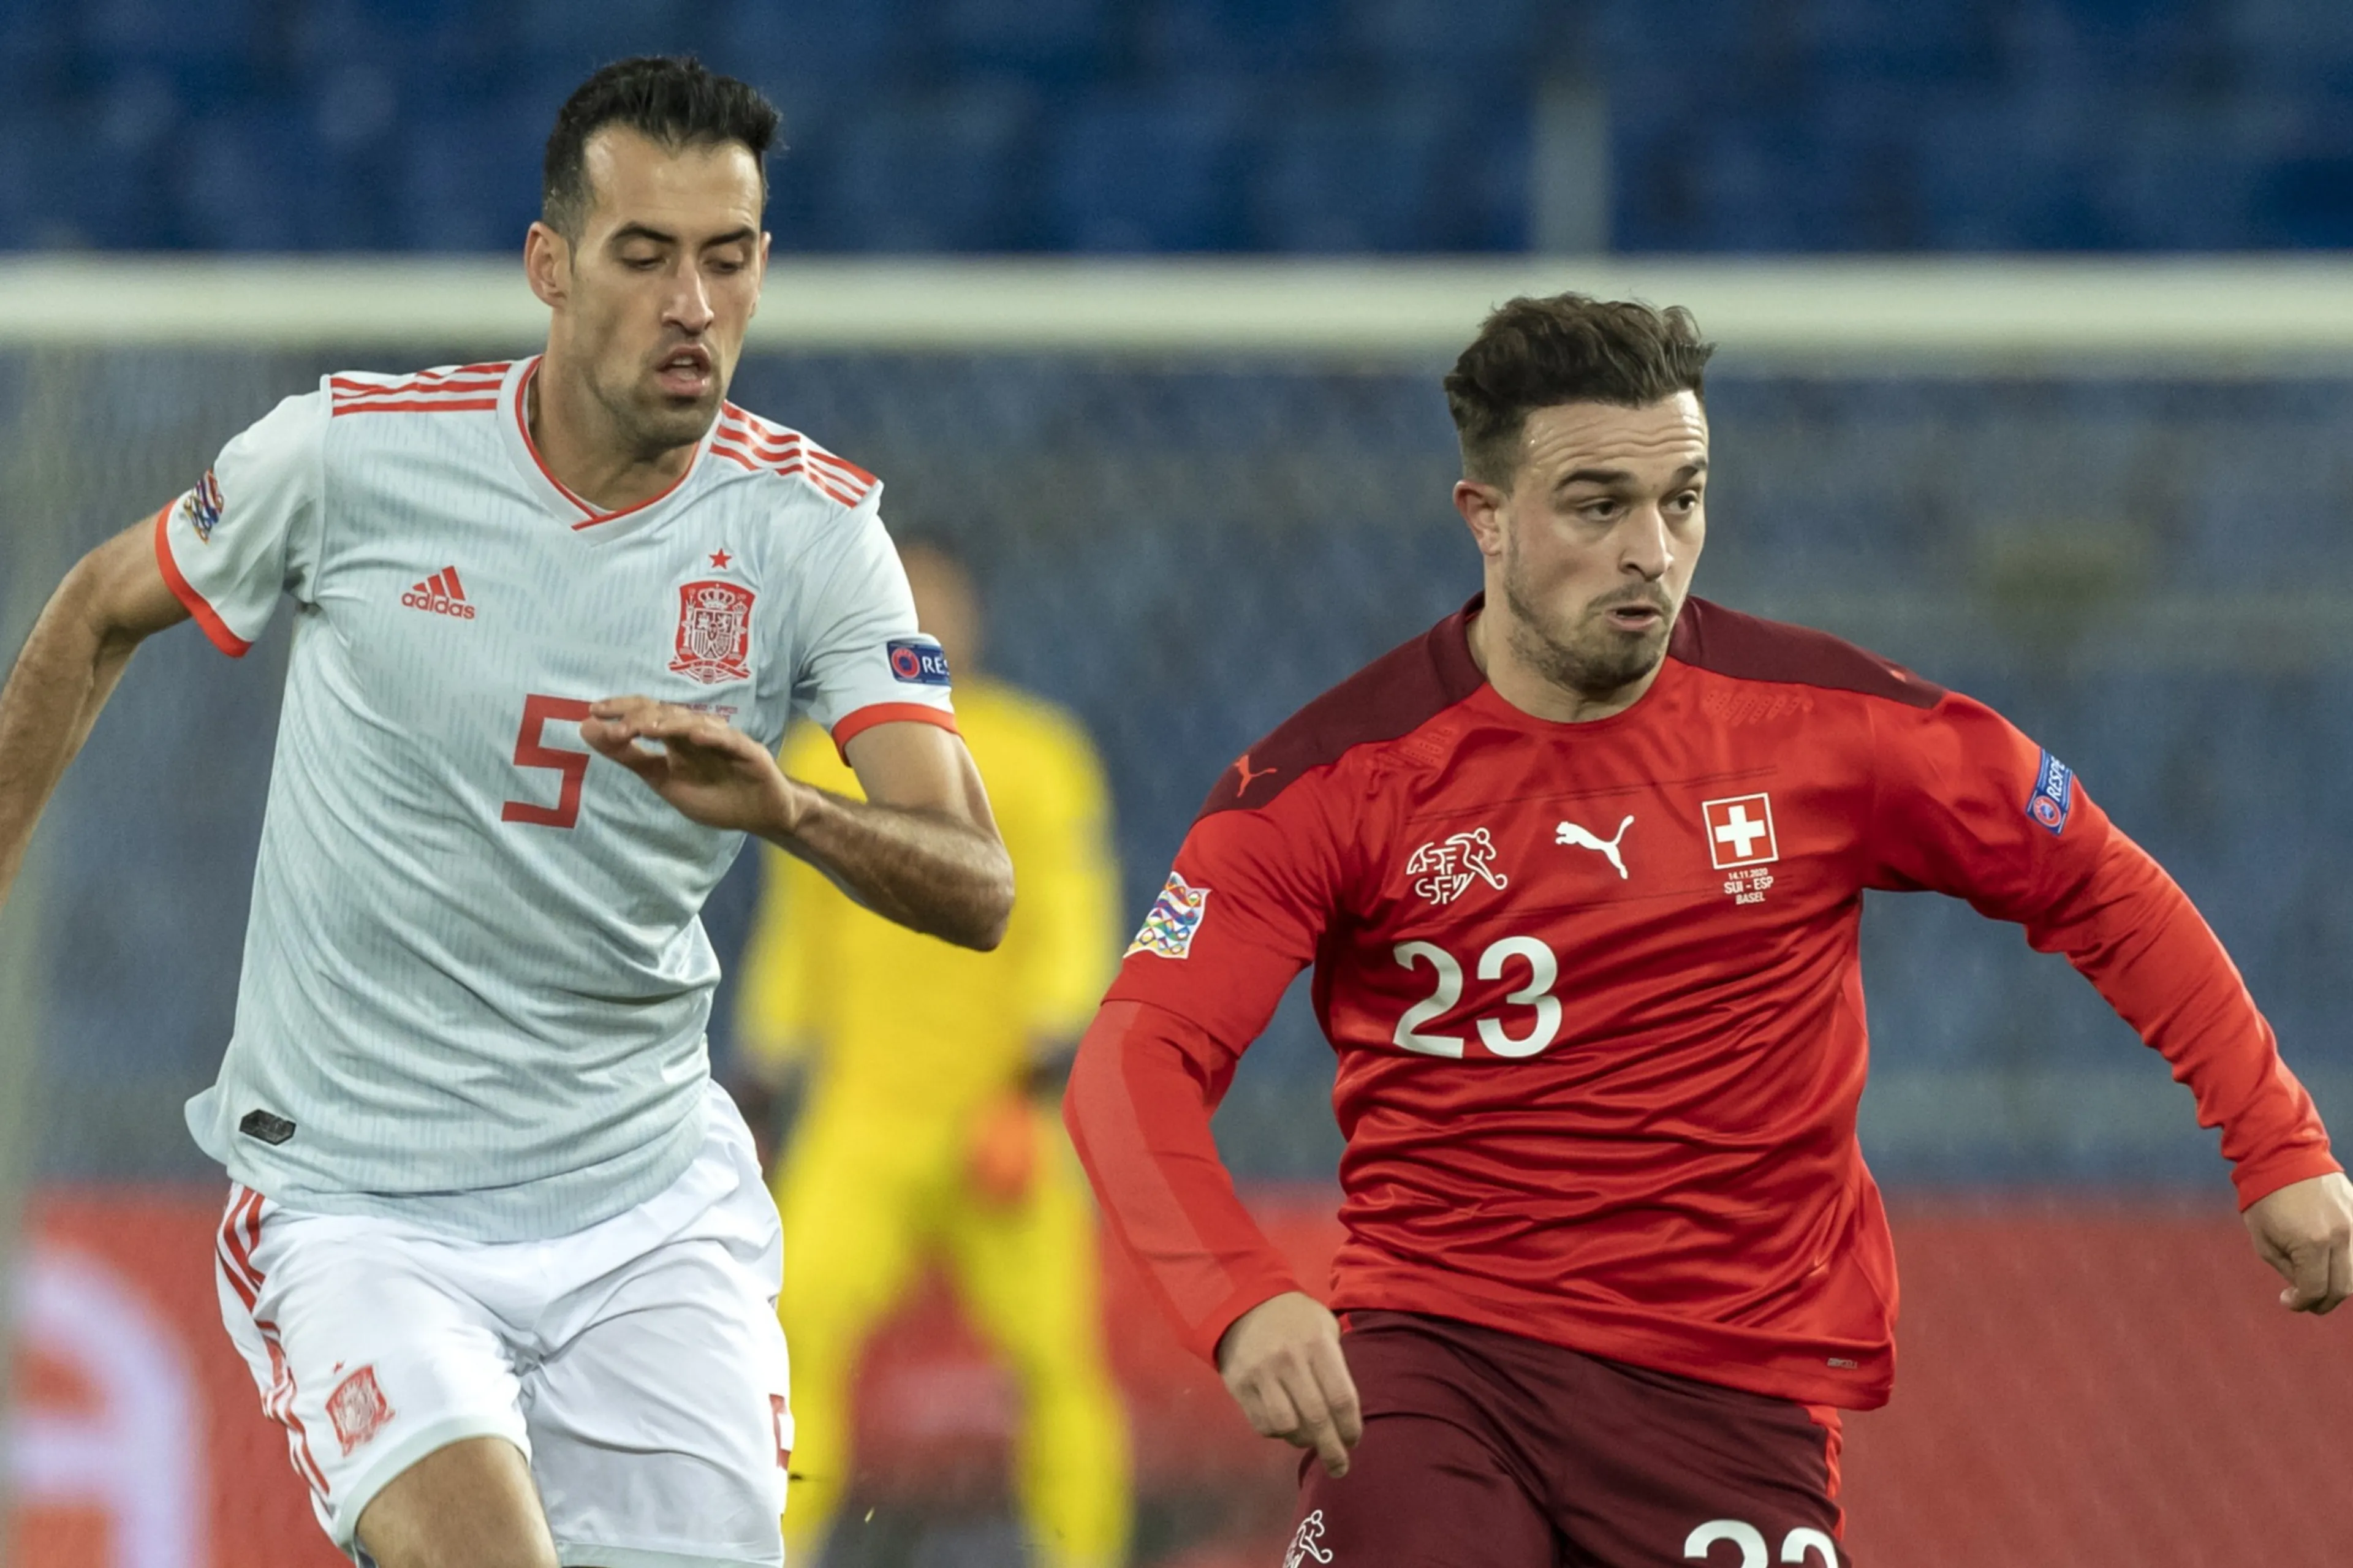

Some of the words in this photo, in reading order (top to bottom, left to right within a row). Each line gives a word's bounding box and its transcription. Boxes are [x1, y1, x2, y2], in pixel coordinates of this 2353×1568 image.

[401, 592, 476, 619] adidas
[501, 693, 591, 829] 5
[1724, 881, 1744, 895] SUI
[1753, 875, 1774, 890] ESP
[1392, 935, 1563, 1059] 23
